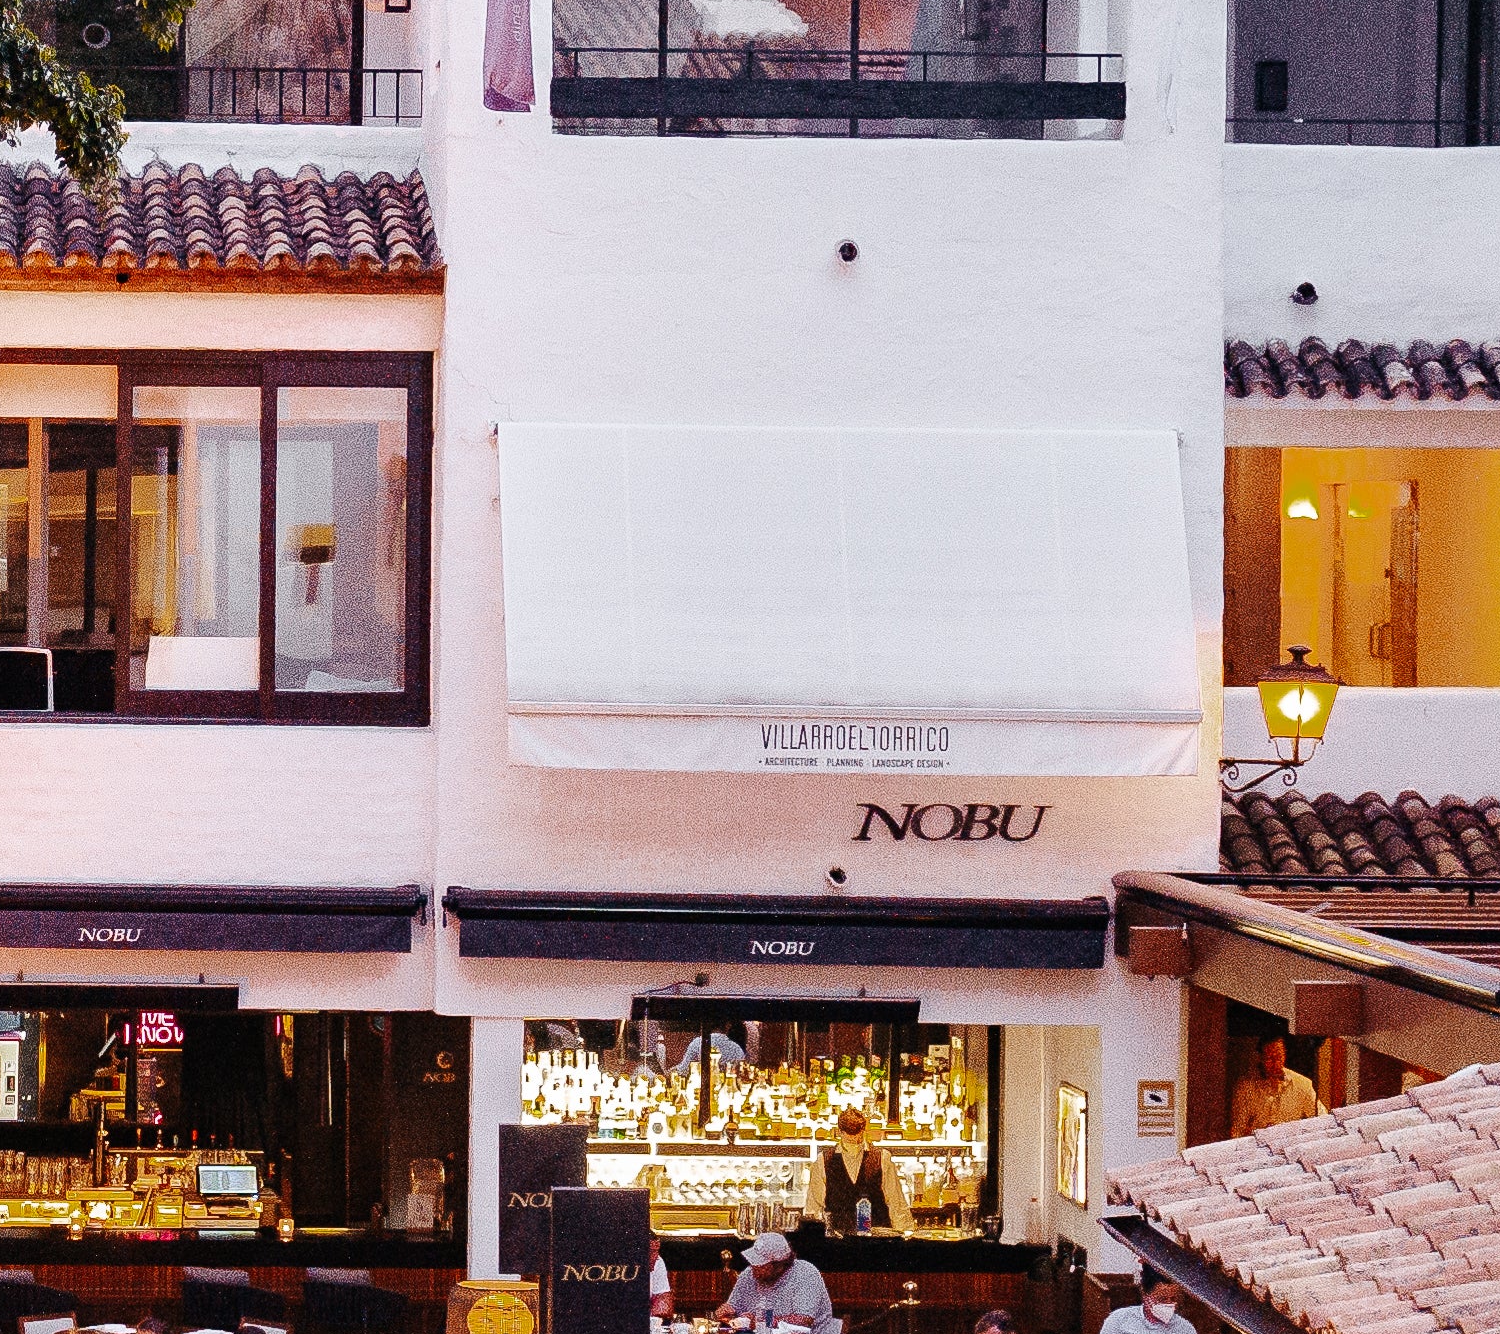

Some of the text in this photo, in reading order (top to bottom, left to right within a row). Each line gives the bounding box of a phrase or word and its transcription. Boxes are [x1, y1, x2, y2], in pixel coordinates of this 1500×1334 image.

[510, 4, 521, 44] dine
[761, 724, 949, 752] VILLARROELTORRICO
[764, 757, 944, 768] ARCHITECTURE PLANNING LANDSCAPE DESIGN
[851, 803, 1054, 843] NOBU
[78, 928, 143, 943] NOBU
[750, 940, 816, 956] NOBU
[507, 1192, 552, 1208] NO
[561, 1264, 641, 1282] NOBU
